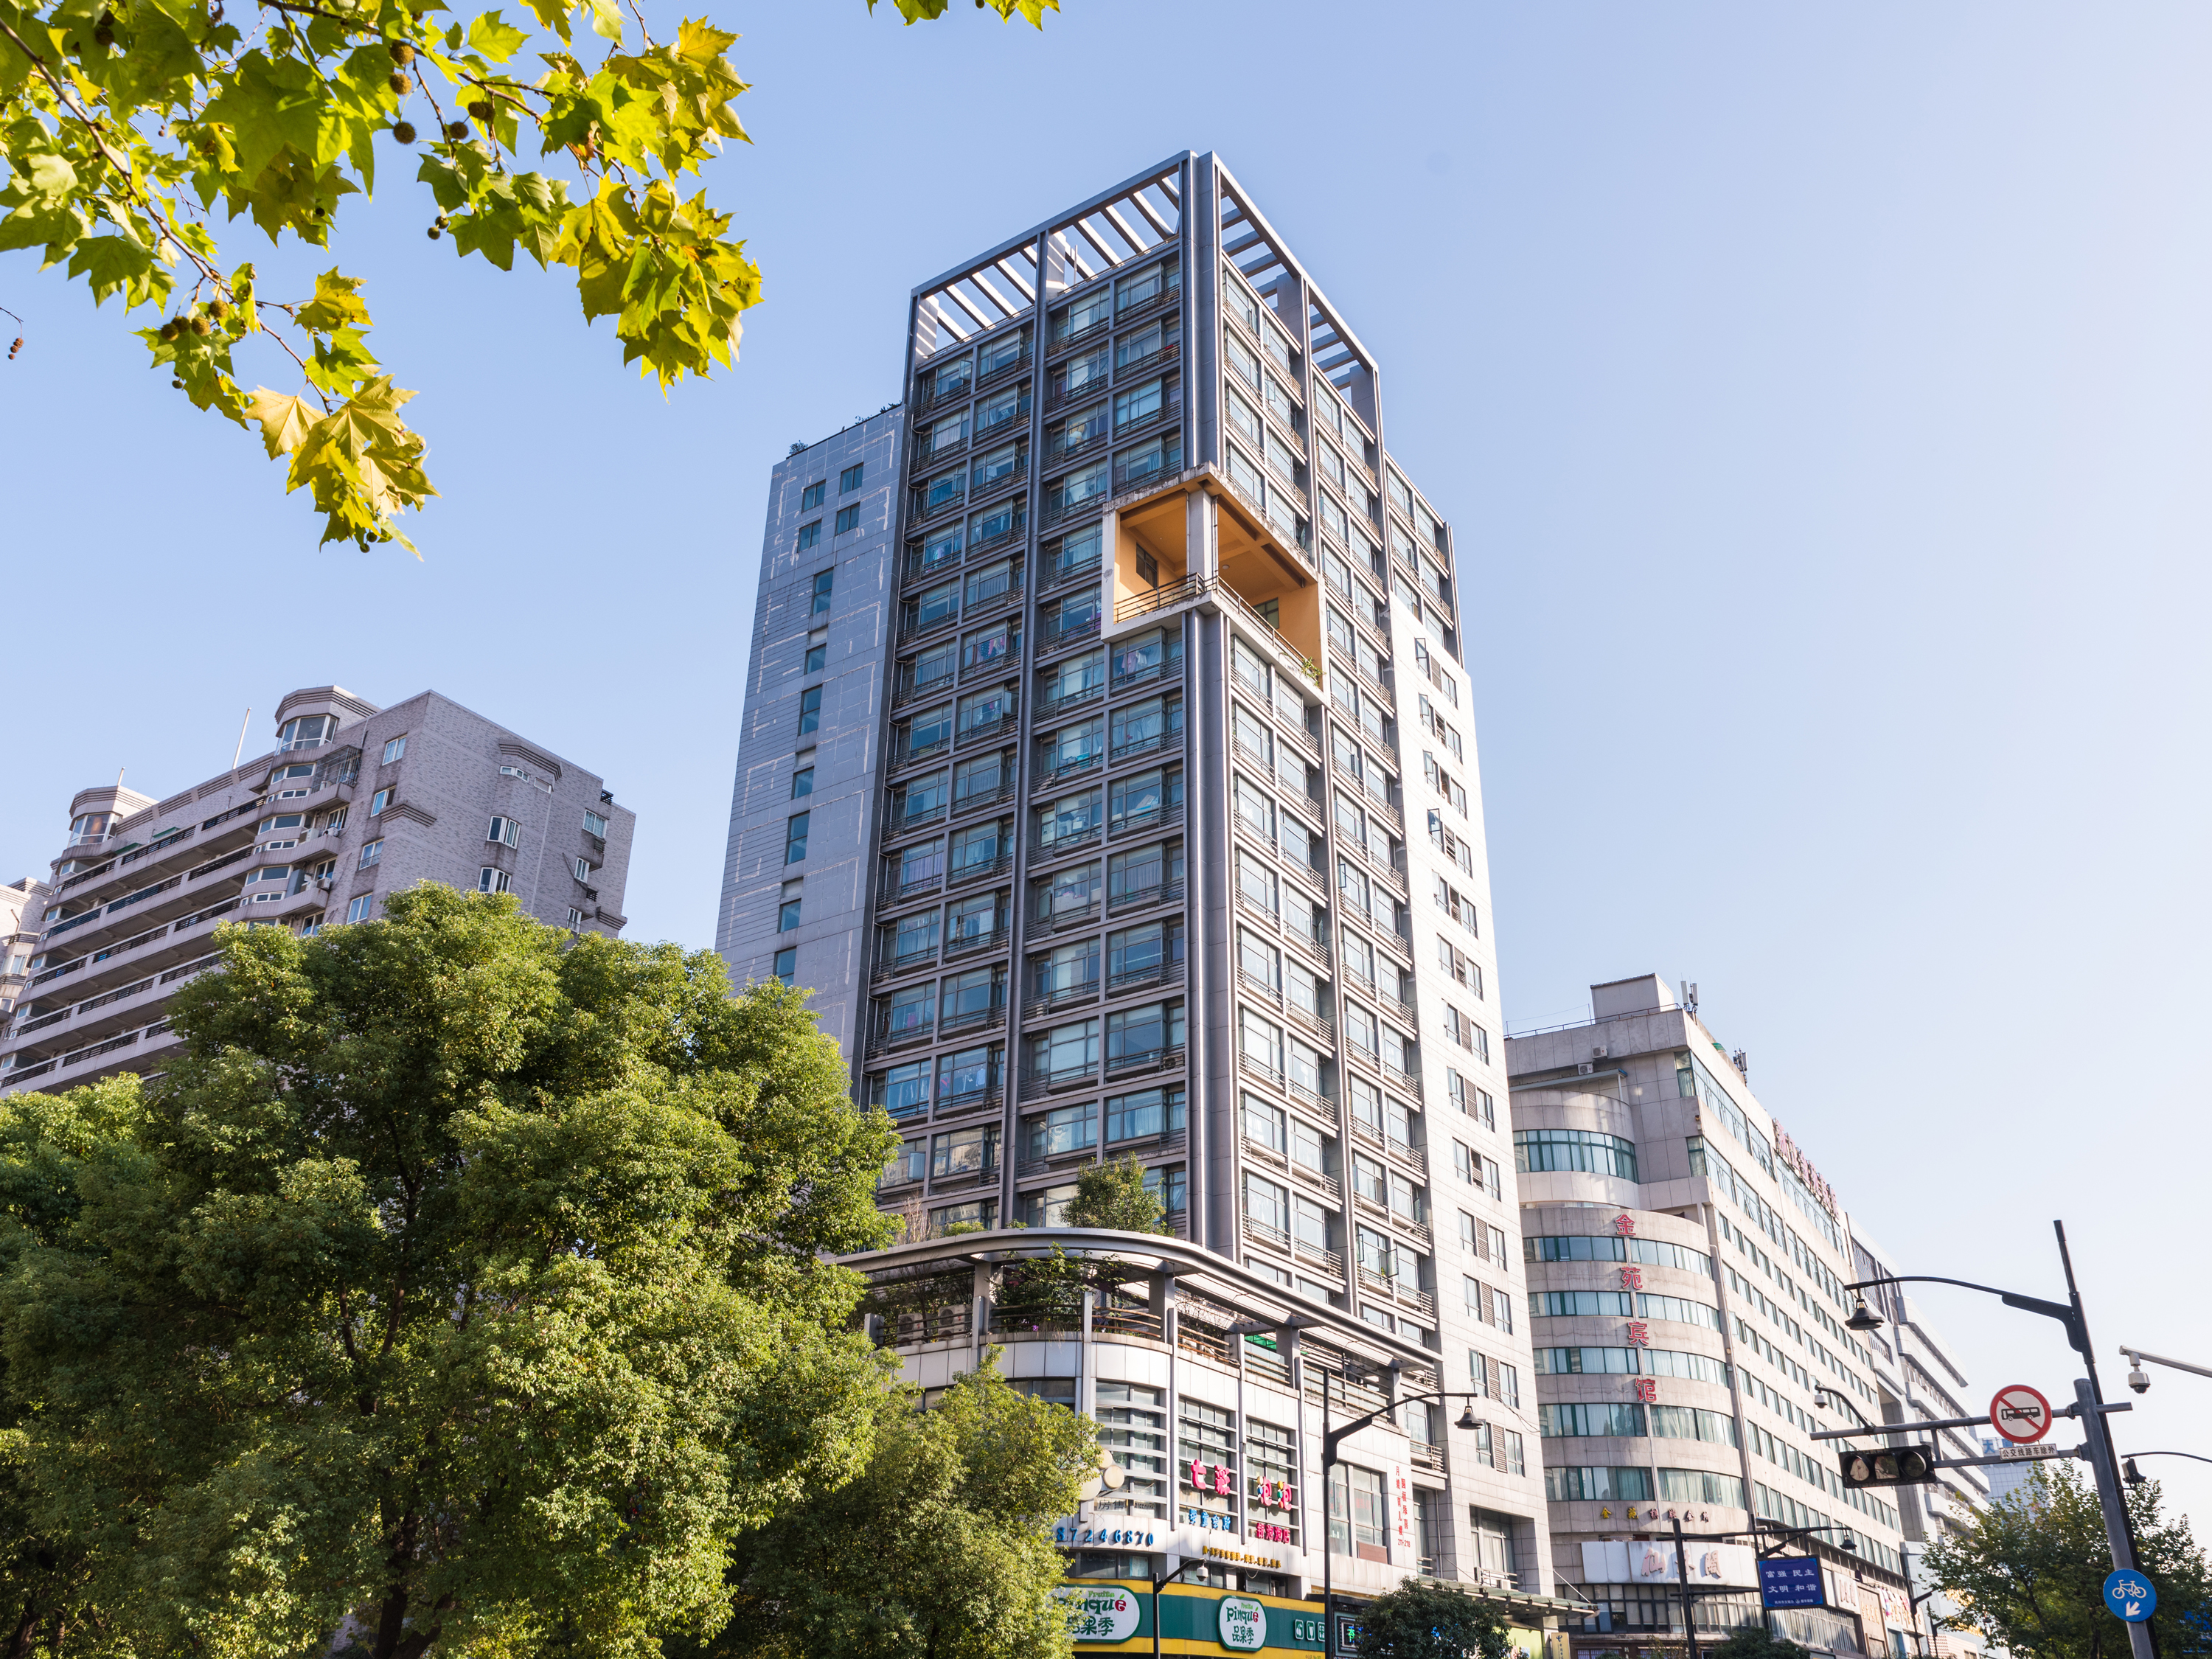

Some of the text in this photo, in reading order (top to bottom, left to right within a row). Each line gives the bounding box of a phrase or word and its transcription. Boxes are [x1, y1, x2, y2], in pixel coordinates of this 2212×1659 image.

[1615, 1214, 1658, 1402] 金苑宾馆
[2002, 1445, 2055, 1458] 公交线路车除外
[1057, 1526, 1154, 1546] 87246870
[1765, 1568, 1815, 1578] 富强 民主
[1768, 1585, 1789, 1593] 文明
[1231, 1625, 1254, 1645] 品果季
